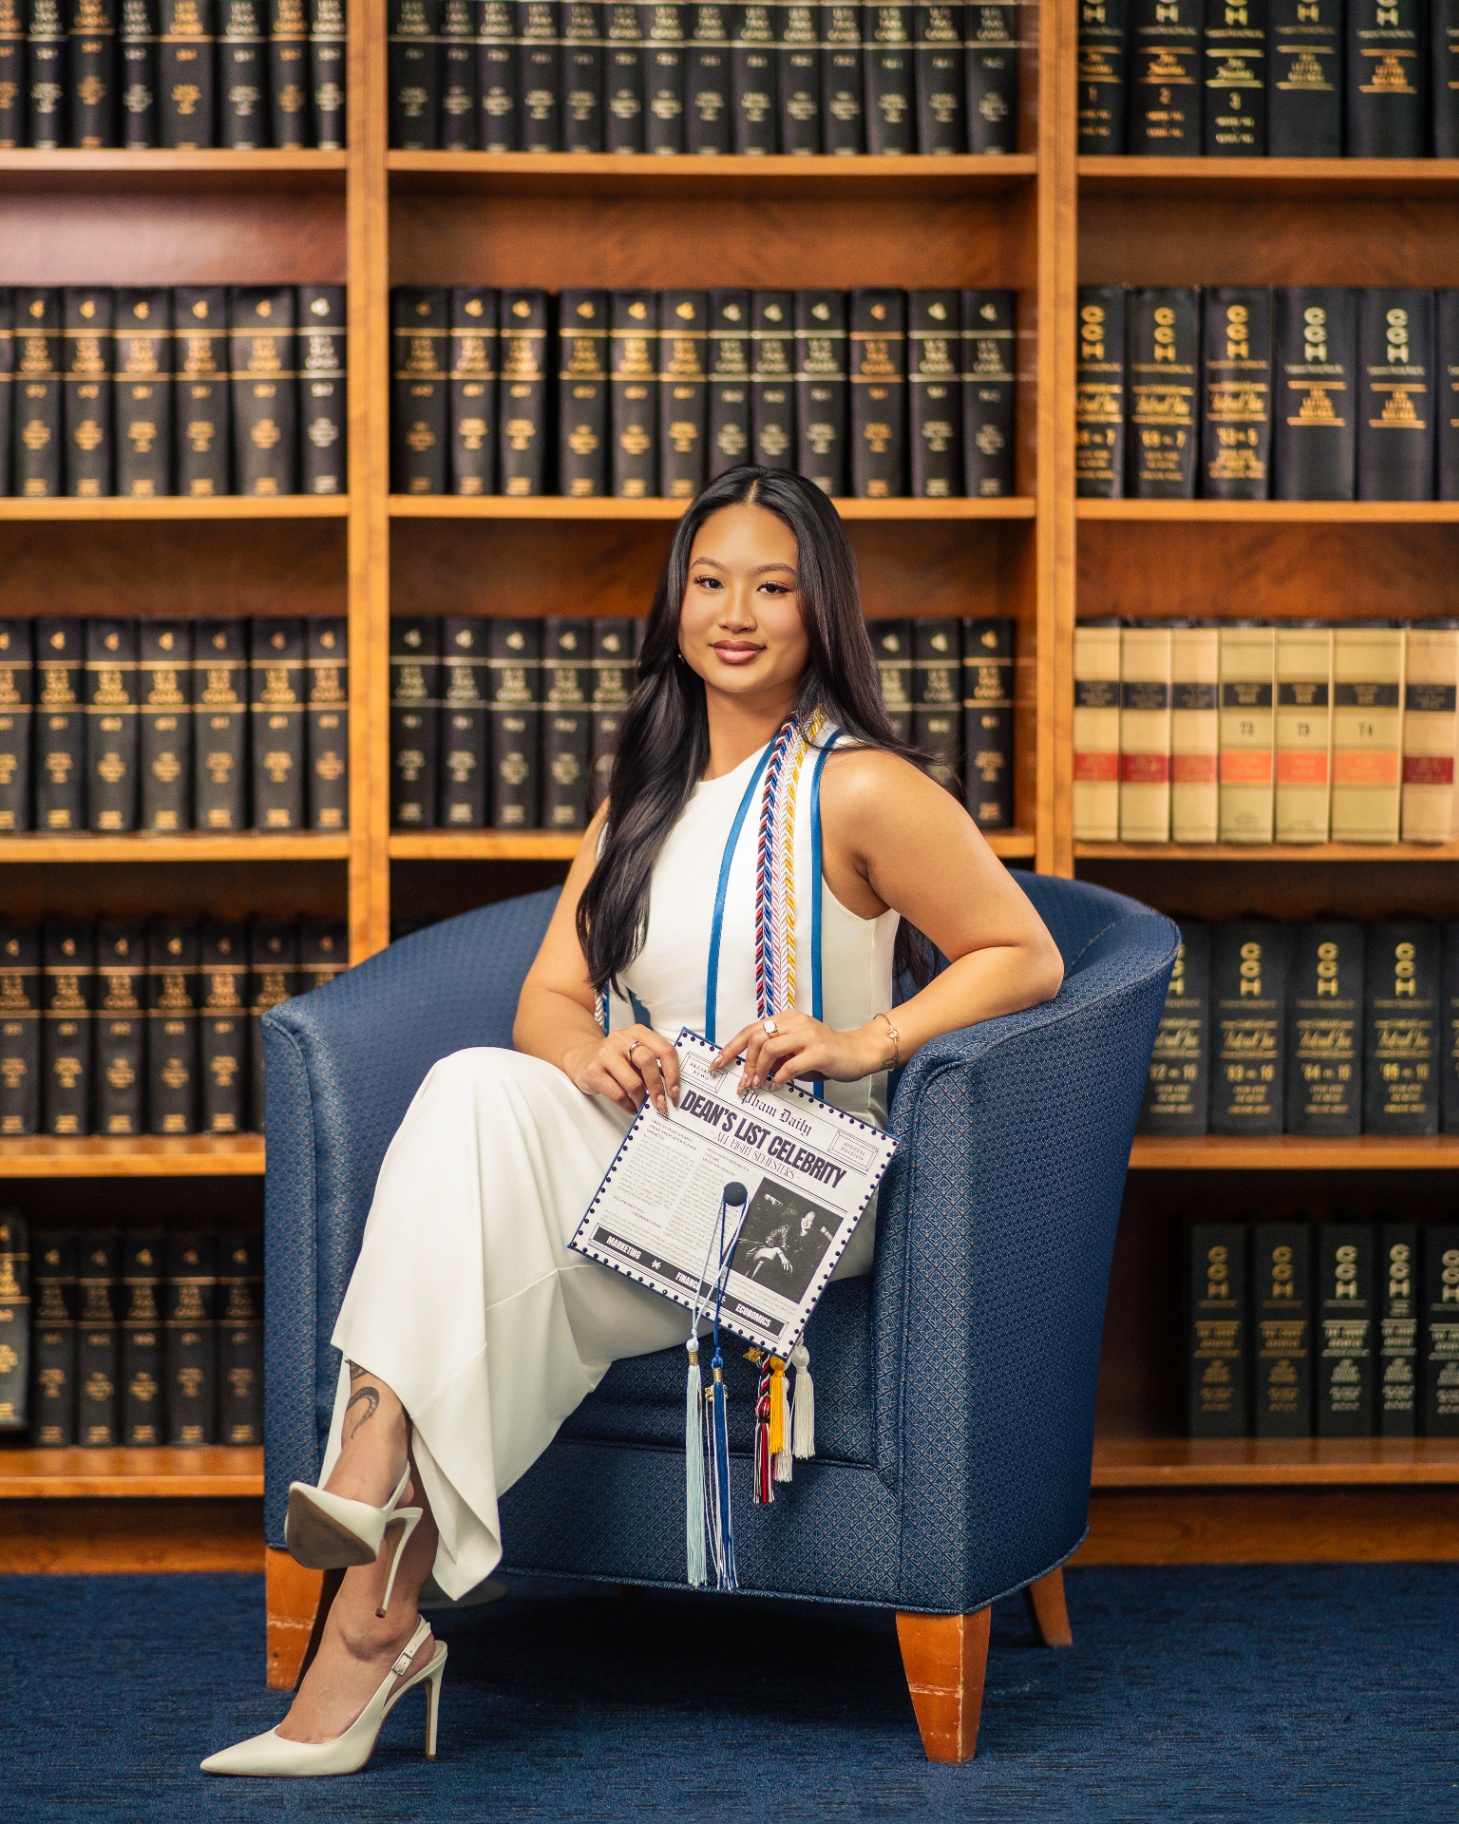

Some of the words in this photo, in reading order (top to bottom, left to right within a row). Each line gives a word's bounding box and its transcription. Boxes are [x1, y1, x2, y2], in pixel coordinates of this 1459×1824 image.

[1159, 87, 1171, 105] 2
[1229, 91, 1241, 110] 3
[1081, 305, 1105, 360] CCH
[1154, 307, 1176, 362] CCH
[1226, 304, 1249, 359] CCH
[1304, 306, 1327, 362] CCH
[1386, 308, 1409, 363] CCH
[1240, 942, 1261, 997] CCH
[1317, 942, 1339, 997] CCH
[1395, 942, 1416, 997] CCH
[680, 1089, 738, 1132] DEAN'S
[734, 1118, 771, 1149] LIST
[767, 1135, 847, 1189] CELEBRITY
[741, 1090, 777, 1117] Pham
[779, 1108, 812, 1136] Daily
[714, 1132, 730, 1145] ALL
[730, 1139, 752, 1157] EIGHT
[753, 1151, 796, 1179] SEMESTERS
[843, 1142, 866, 1156] SPECIAL
[606, 1235, 642, 1260] MARKETING
[675, 1271, 700, 1289] FINANC
[735, 1303, 772, 1328] ECONOMICS
[1207, 1245, 1229, 1298] CCH
[1271, 1245, 1294, 1298] CCH
[1335, 1245, 1358, 1299] CCH
[1389, 1243, 1411, 1298] CCH
